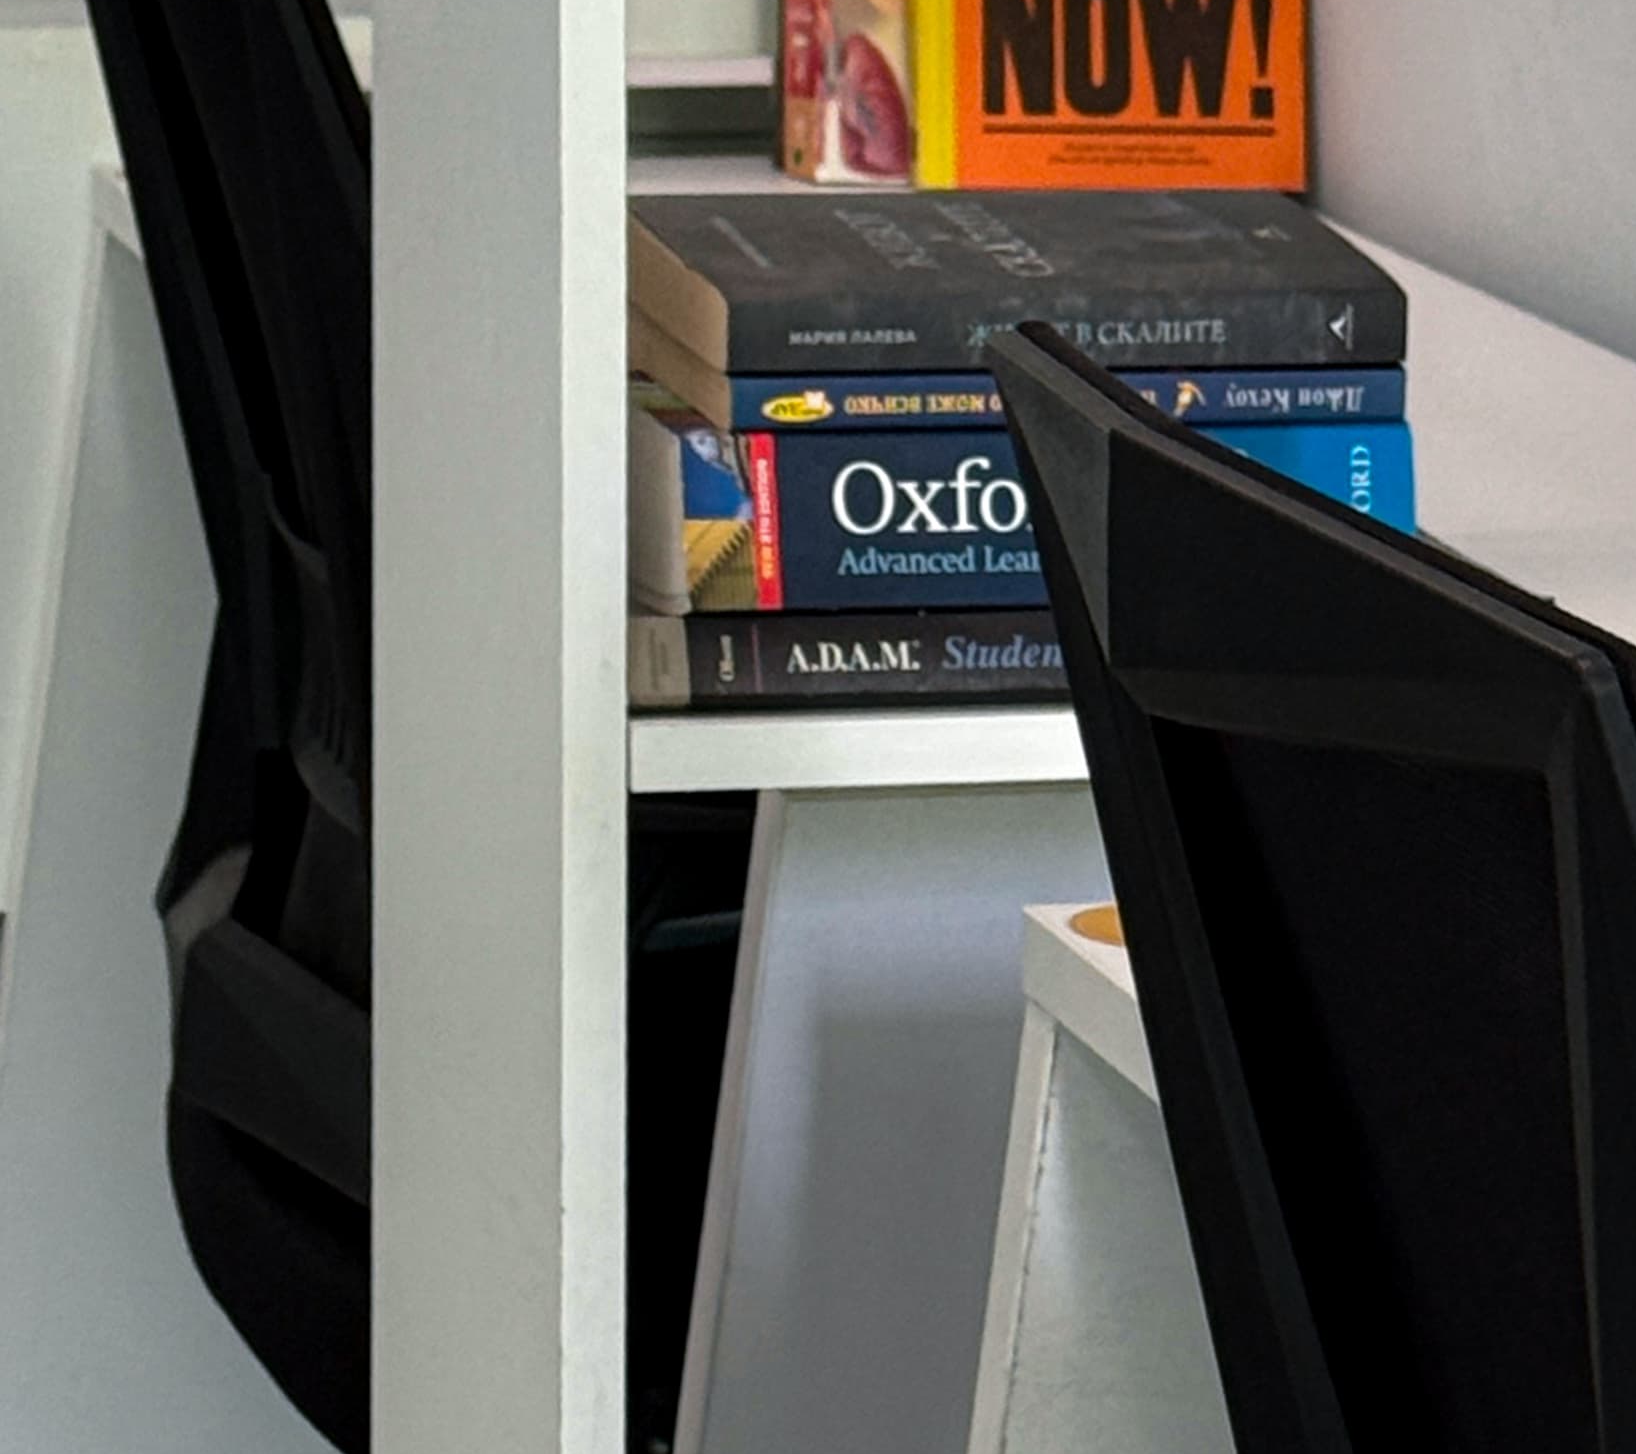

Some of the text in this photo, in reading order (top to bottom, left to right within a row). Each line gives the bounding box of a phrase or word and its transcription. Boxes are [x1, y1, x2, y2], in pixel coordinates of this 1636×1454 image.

[1096, 317, 1227, 346] СКАЛИТЕ
[843, 394, 922, 415] ВСИЧКО
[831, 456, 1033, 535] Oxfo
[837, 544, 977, 576] Advanced
